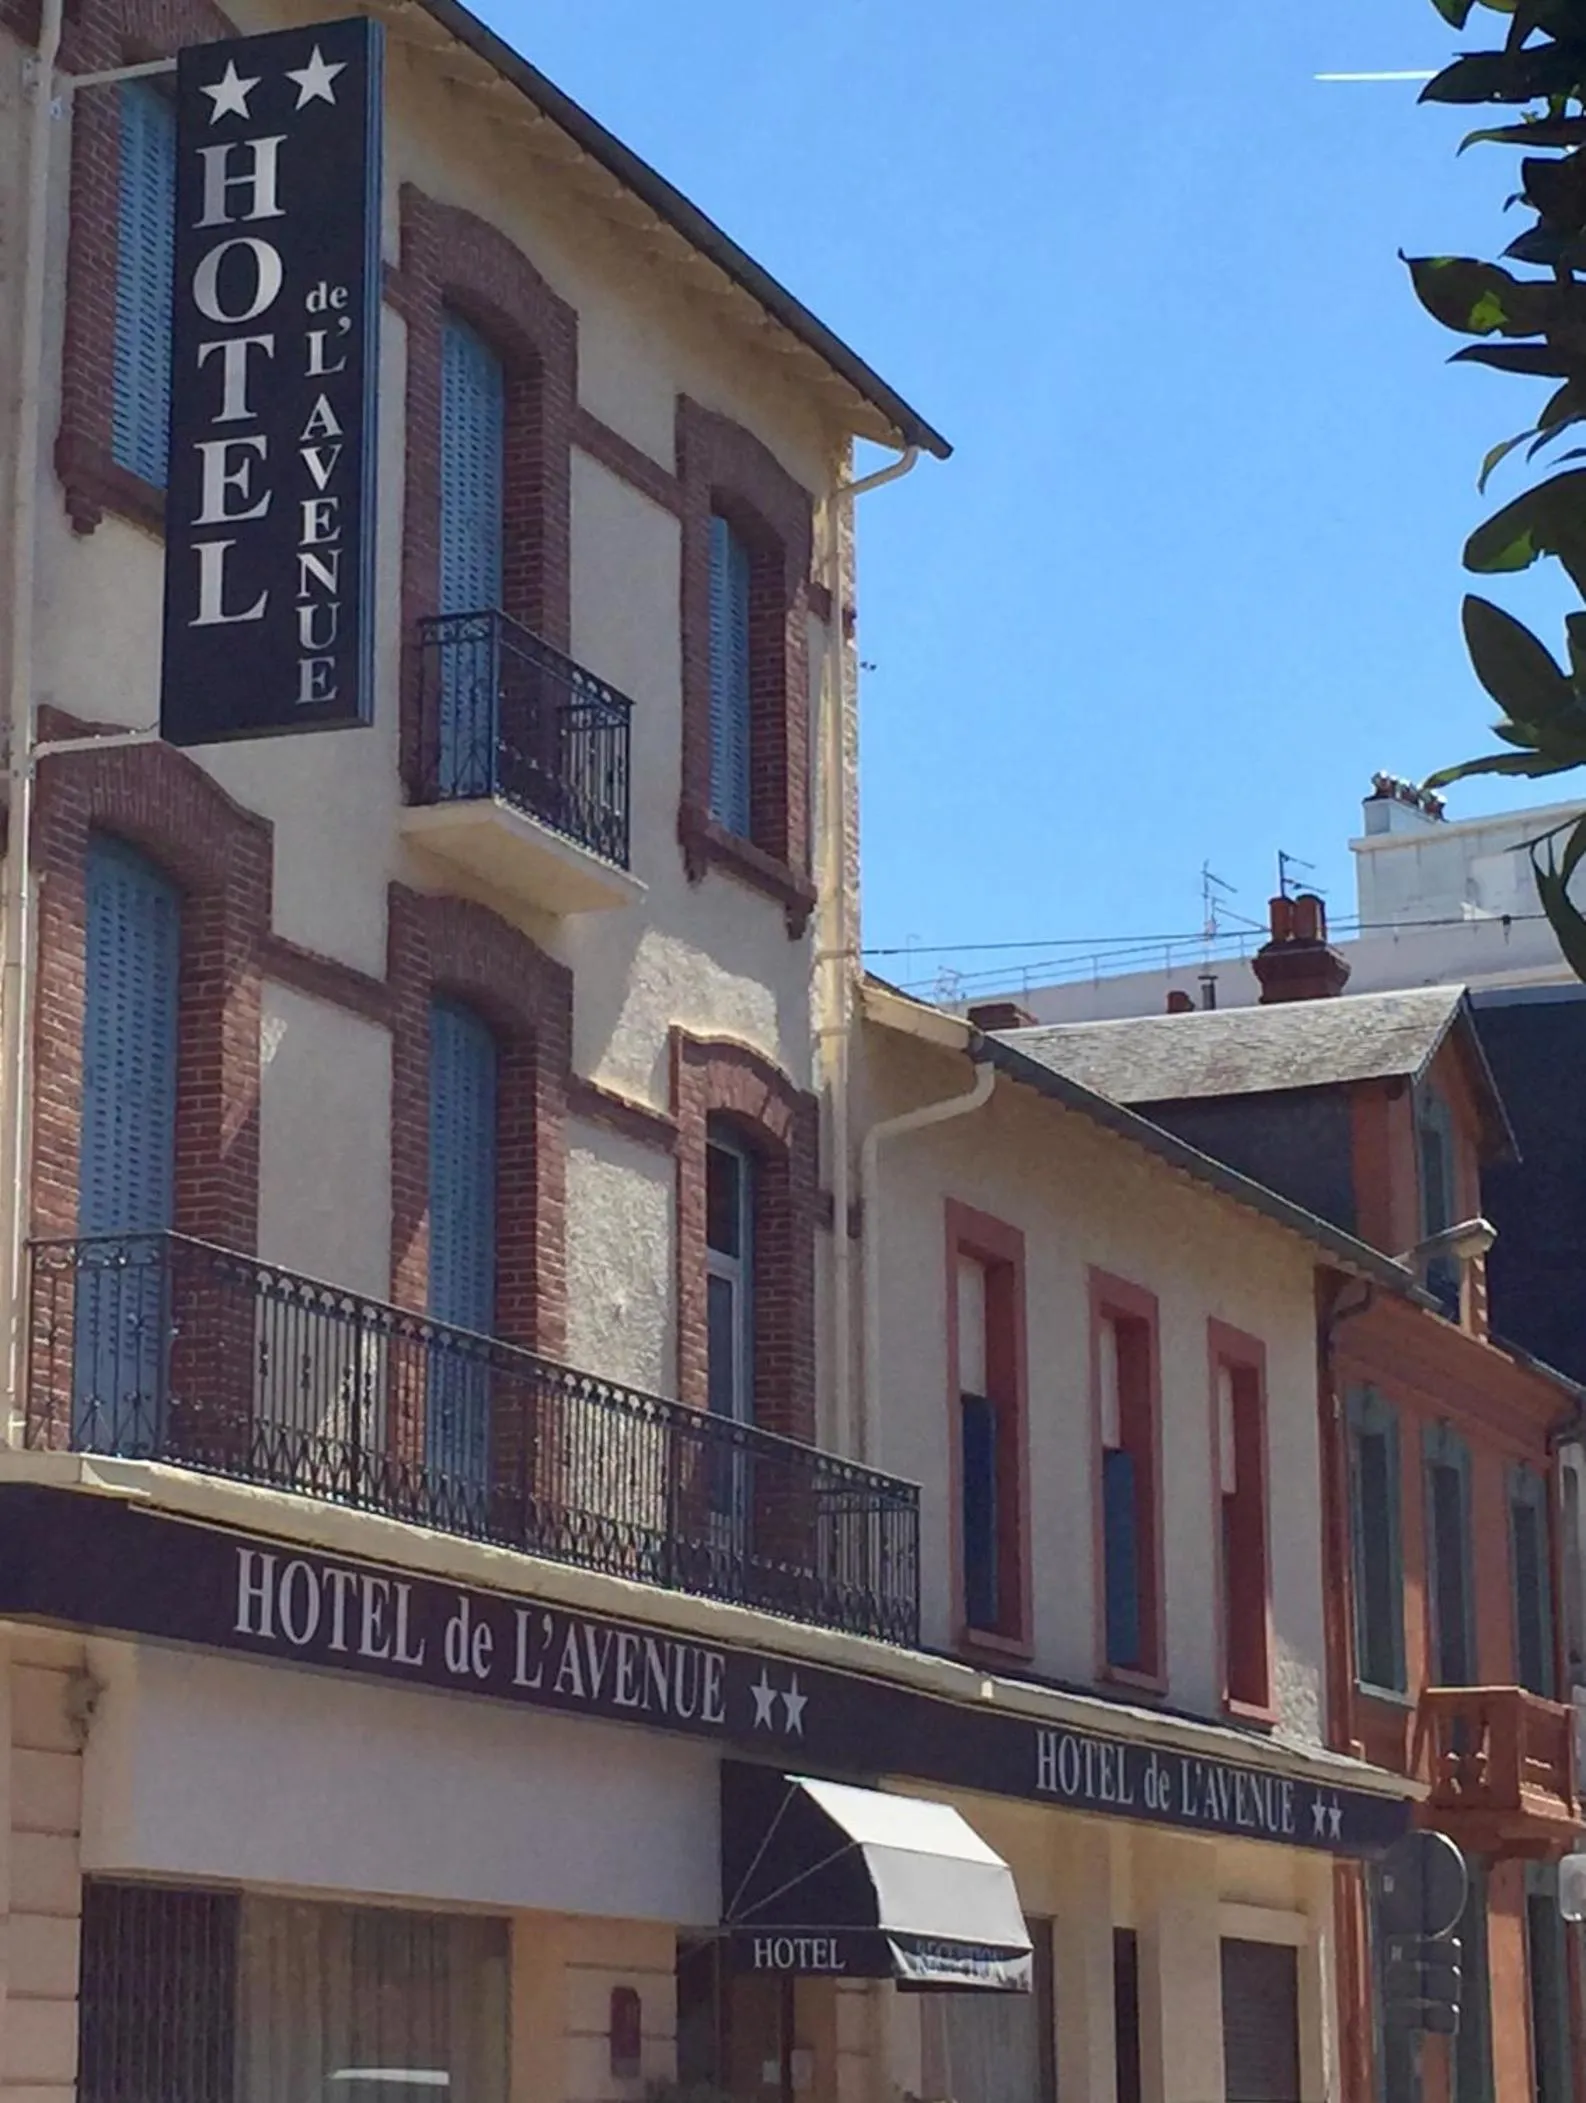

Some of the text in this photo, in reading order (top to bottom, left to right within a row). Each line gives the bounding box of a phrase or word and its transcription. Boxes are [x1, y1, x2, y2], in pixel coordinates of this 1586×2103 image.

[191, 135, 288, 627] HOTEL
[296, 281, 353, 705] de L'AVENUE
[234, 1547, 727, 1723] HOTEL de L'AVENUE
[1036, 1730, 1295, 1834] HOTEL de L'AVENUE
[753, 1938, 847, 1969] HOTEL
